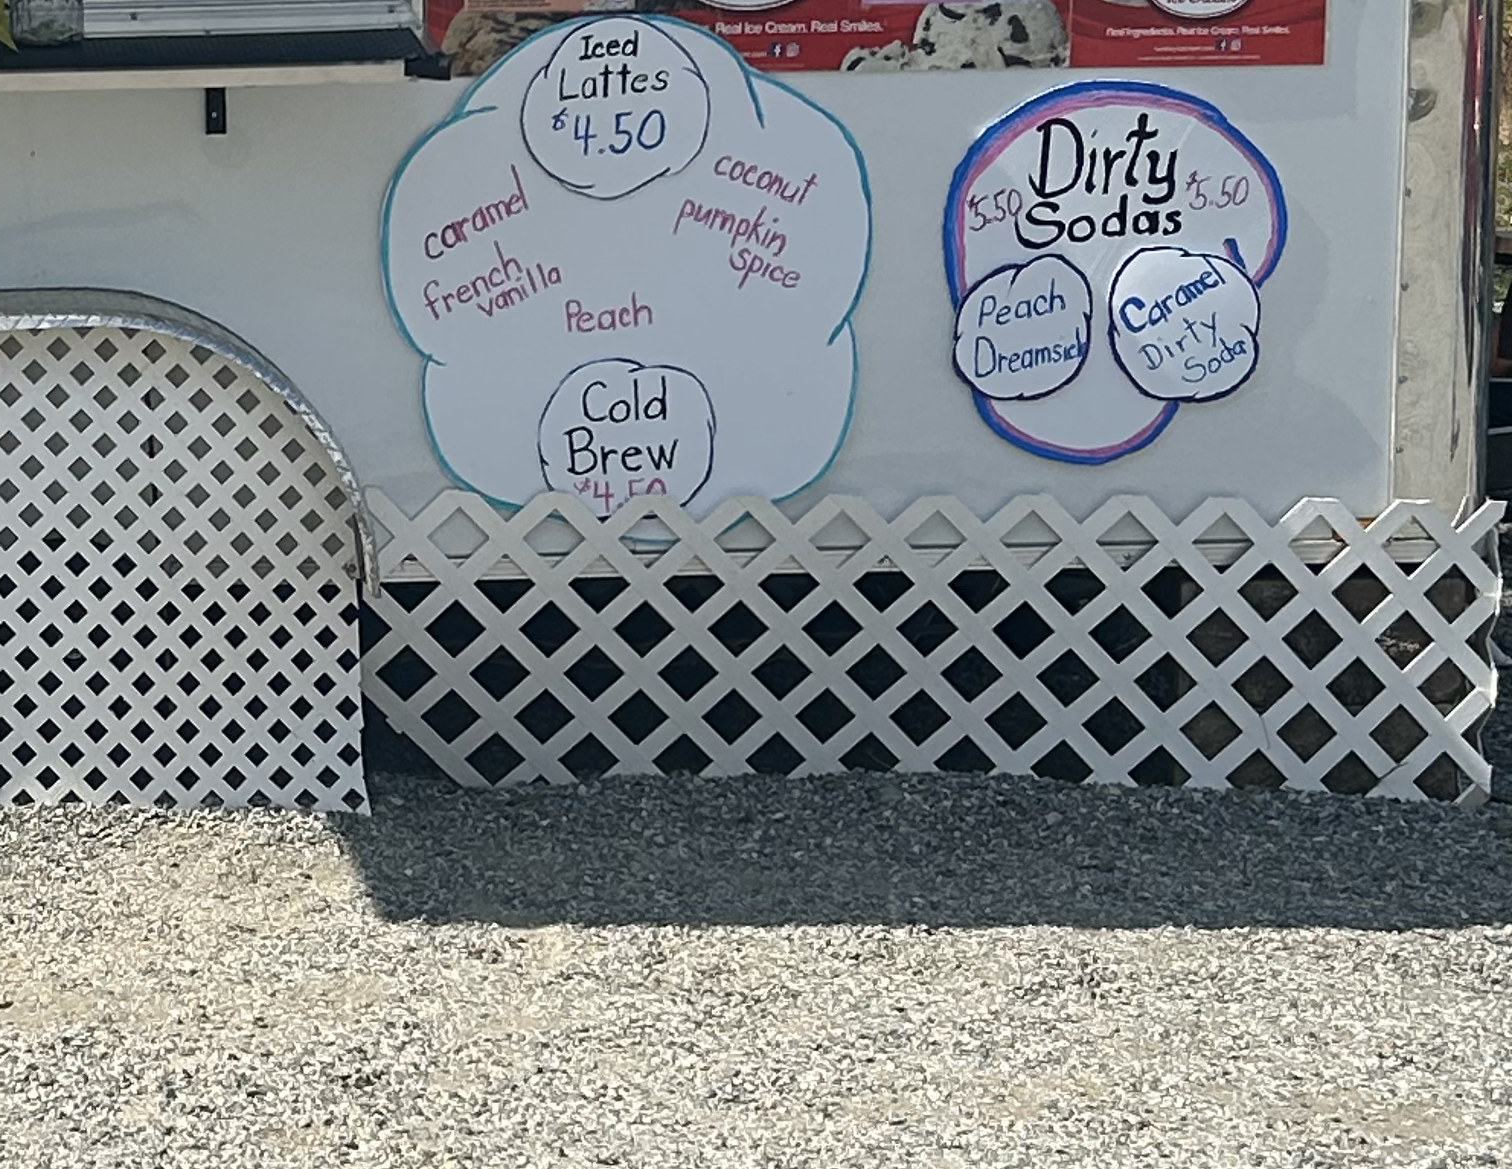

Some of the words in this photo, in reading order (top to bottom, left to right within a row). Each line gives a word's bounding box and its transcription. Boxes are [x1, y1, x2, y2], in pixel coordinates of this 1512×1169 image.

[579, 30, 638, 60] Iced
[559, 65, 670, 101] Lattes
[551, 107, 667, 156] $4.50
[713, 154, 818, 205] coconut
[1028, 113, 1179, 205] Dirty
[424, 163, 530, 260] caramel
[966, 188, 1024, 233] $5.50
[1186, 170, 1250, 211] $5.50
[672, 198, 787, 258] pumpkin
[1015, 195, 1182, 250] Sodas
[422, 241, 524, 320] french
[476, 263, 563, 318] vanilla
[728, 247, 801, 290] spice
[565, 292, 653, 333] Peach
[979, 278, 1066, 328] Peach
[1119, 256, 1226, 333] Caramel
[1138, 312, 1219, 370] Dirty
[1182, 337, 1247, 384] Soda
[581, 375, 668, 424] Cold
[563, 426, 679, 476] Brew
